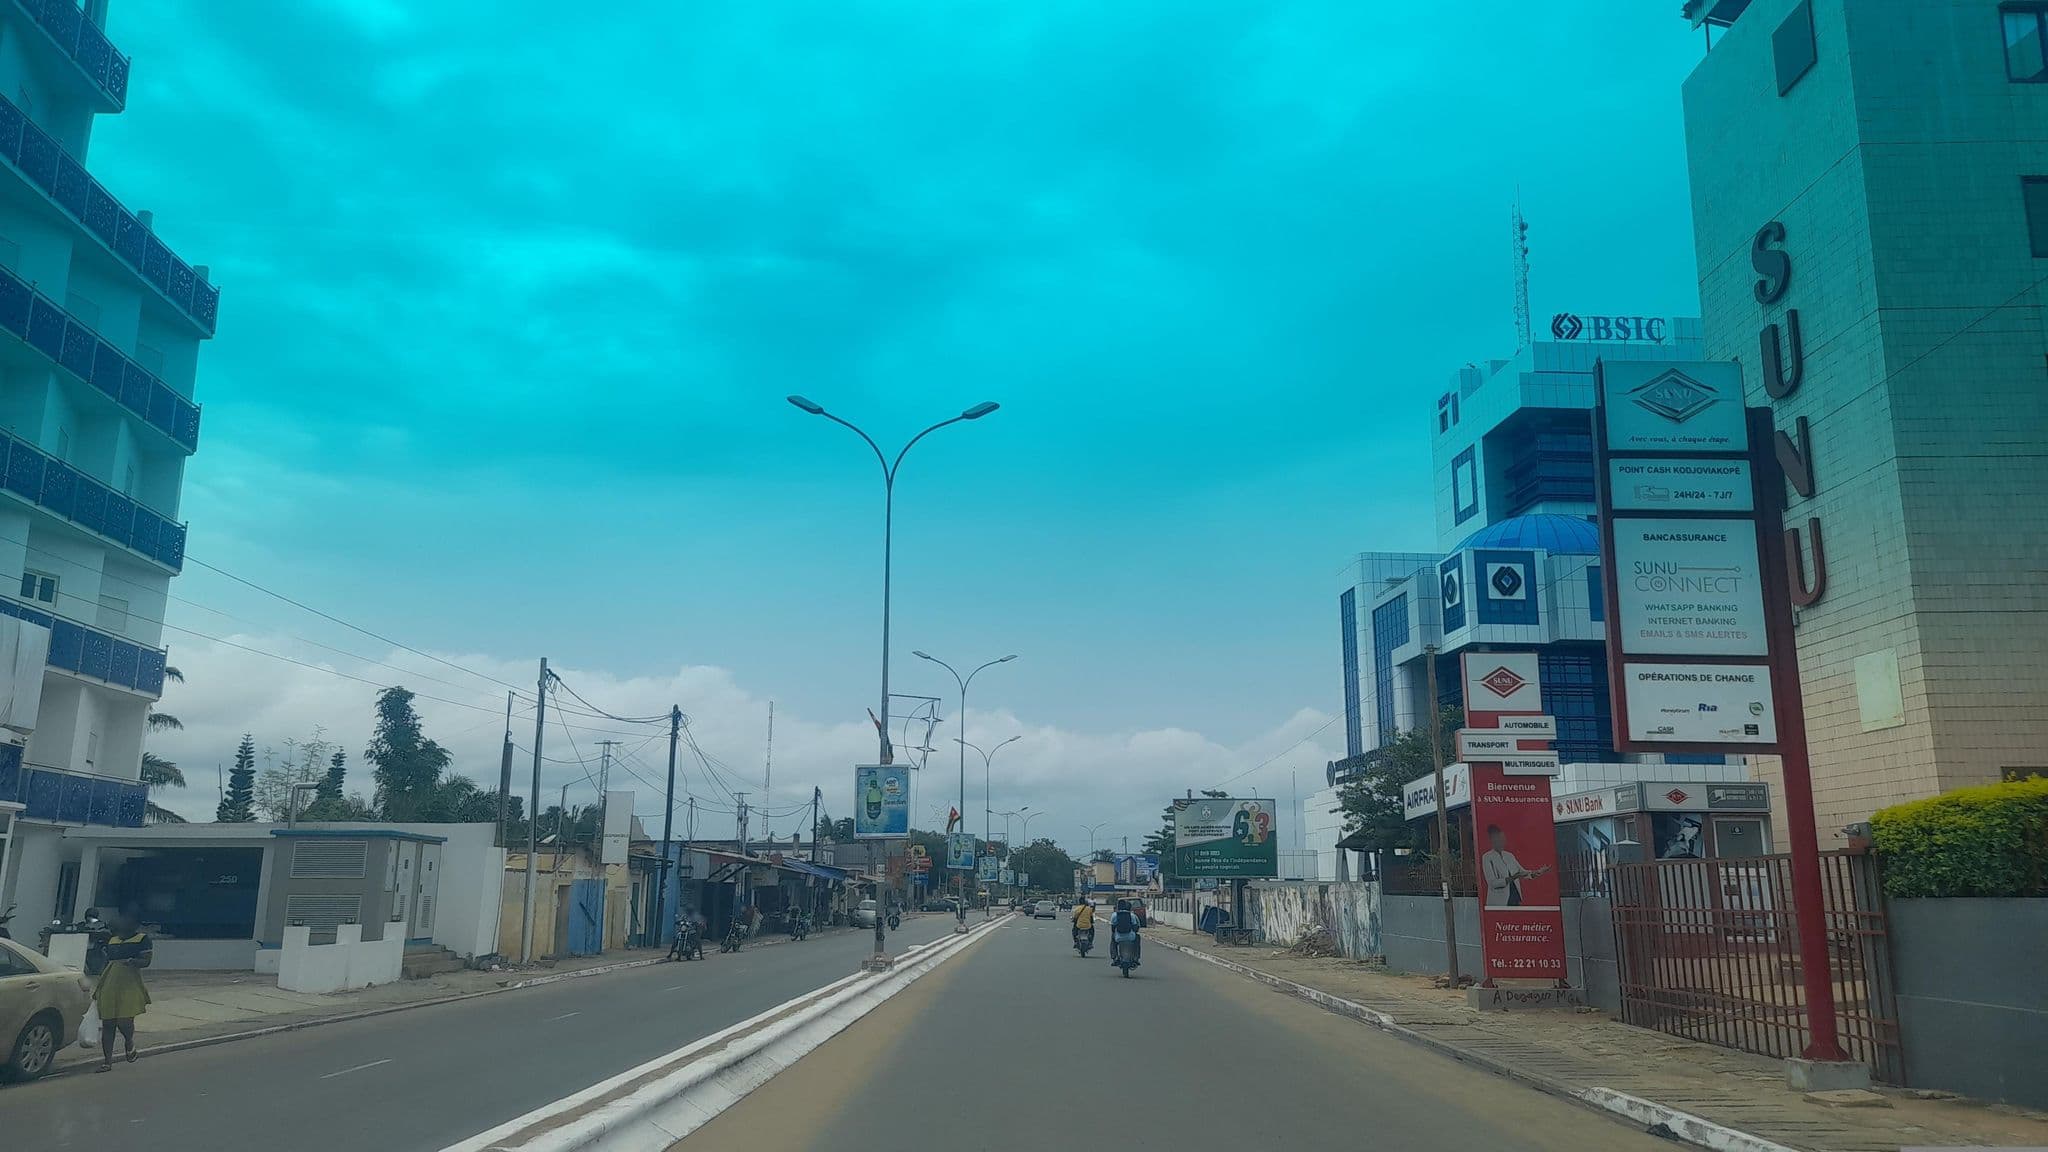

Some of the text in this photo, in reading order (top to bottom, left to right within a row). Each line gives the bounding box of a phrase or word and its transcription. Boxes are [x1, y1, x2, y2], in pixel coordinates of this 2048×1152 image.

[1592, 316, 1667, 342] BSIC
[1752, 221, 1827, 606] SUNU
[1619, 466, 1645, 474] POINT
[1674, 490, 1706, 499] 24H/24
[1642, 533, 1728, 542] BANCASSURANCE
[1634, 560, 1678, 575] SUNU
[1634, 575, 1743, 594] CONNECT
[1645, 603, 1738, 612] WHATSAPP BANKING
[1647, 617, 1737, 625] INTERNET BANKING
[1640, 629, 1674, 638] EMAILS
[1685, 630, 1707, 638] SMS
[1706, 631, 1748, 640] ALERTES
[1638, 672, 1755, 683] OPÉRATIONS DE CHANGE
[1467, 741, 1510, 749] TRANSPORT
[1504, 760, 1555, 768] MULTIRISQUES
[1487, 782, 1536, 791] Bienvenue
[1484, 795, 1504, 803] SUNU
[1505, 795, 1549, 803] Assurances
[1566, 795, 1604, 815] SUNU Bank
[1495, 922, 1553, 933] Notre métier,
[1514, 959, 1525, 968] 22
[1526, 959, 1536, 968] 21
[1539, 959, 1549, 968] 10
[1551, 959, 1561, 968] 33
